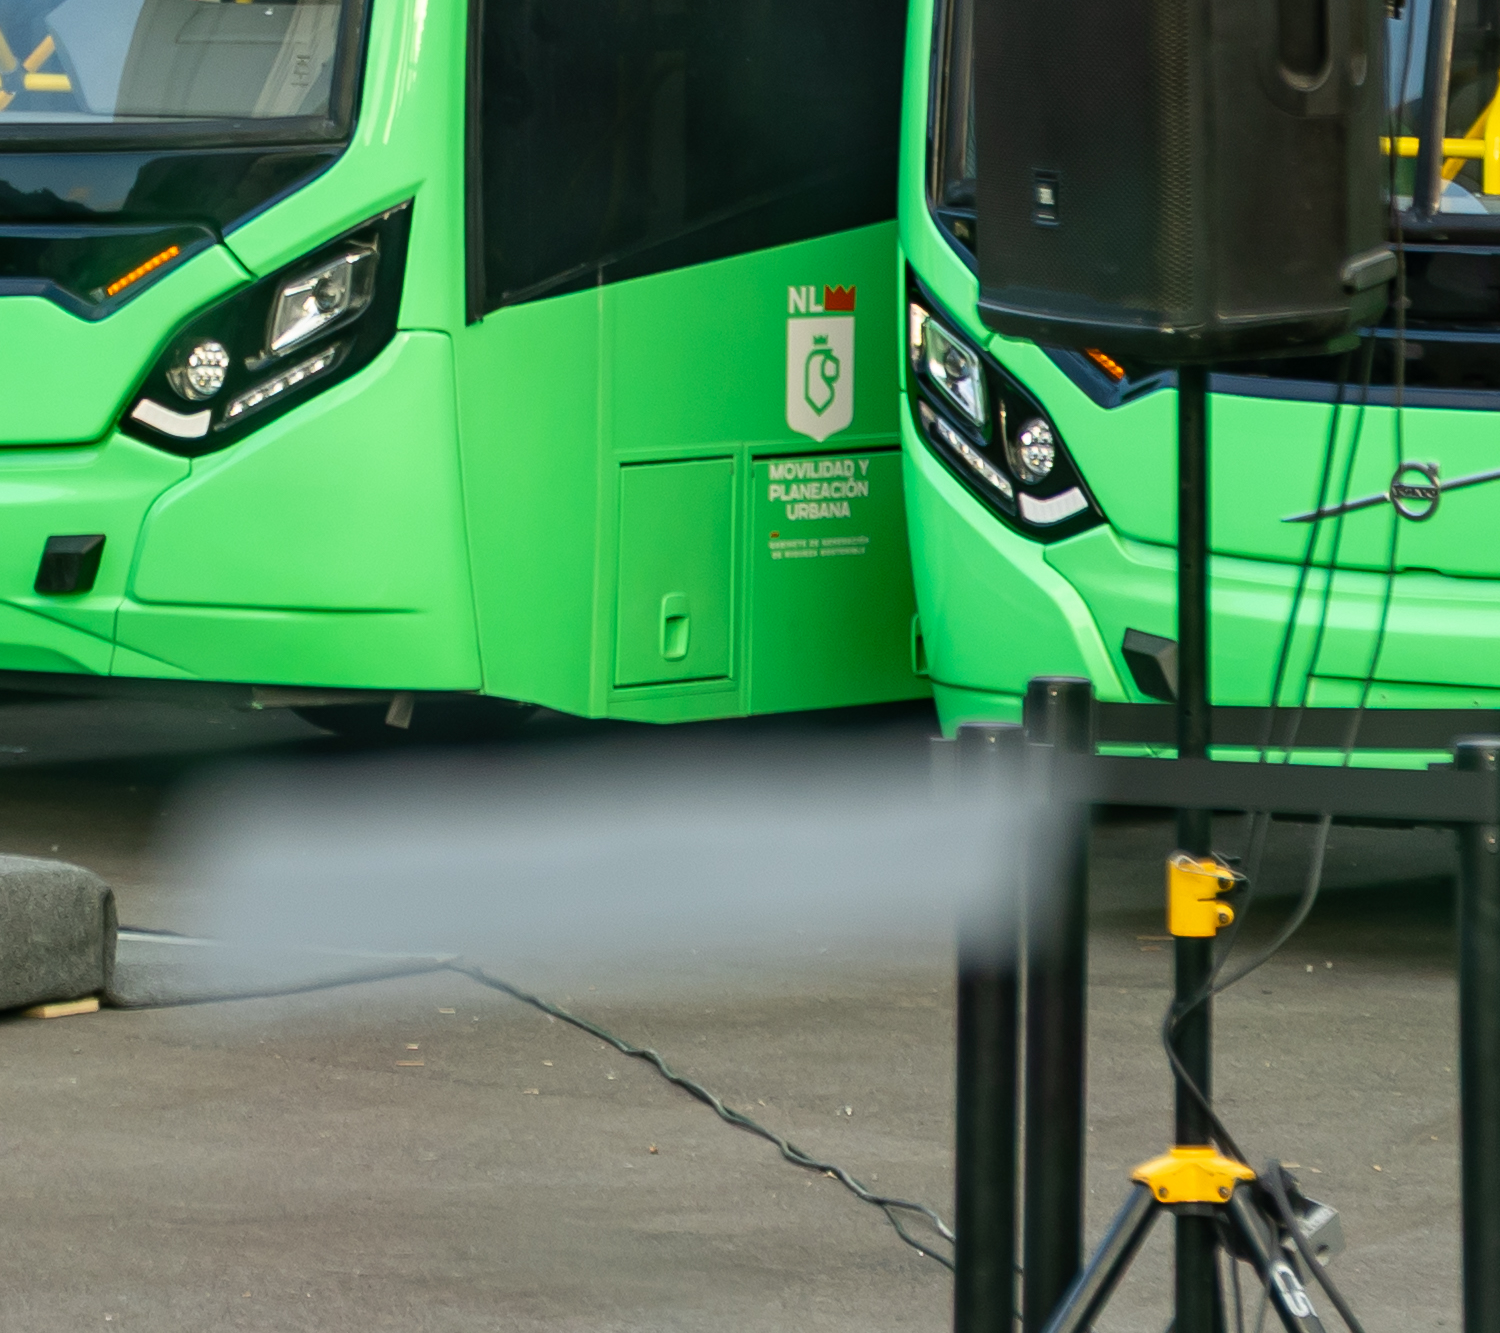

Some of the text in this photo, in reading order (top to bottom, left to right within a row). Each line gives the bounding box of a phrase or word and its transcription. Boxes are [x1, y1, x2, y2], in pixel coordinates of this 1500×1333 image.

[787, 285, 824, 314] NL
[768, 459, 869, 481] MOVILIDAD Y
[768, 477, 869, 502] PLANEACIÓN
[786, 501, 851, 521] URBANA
